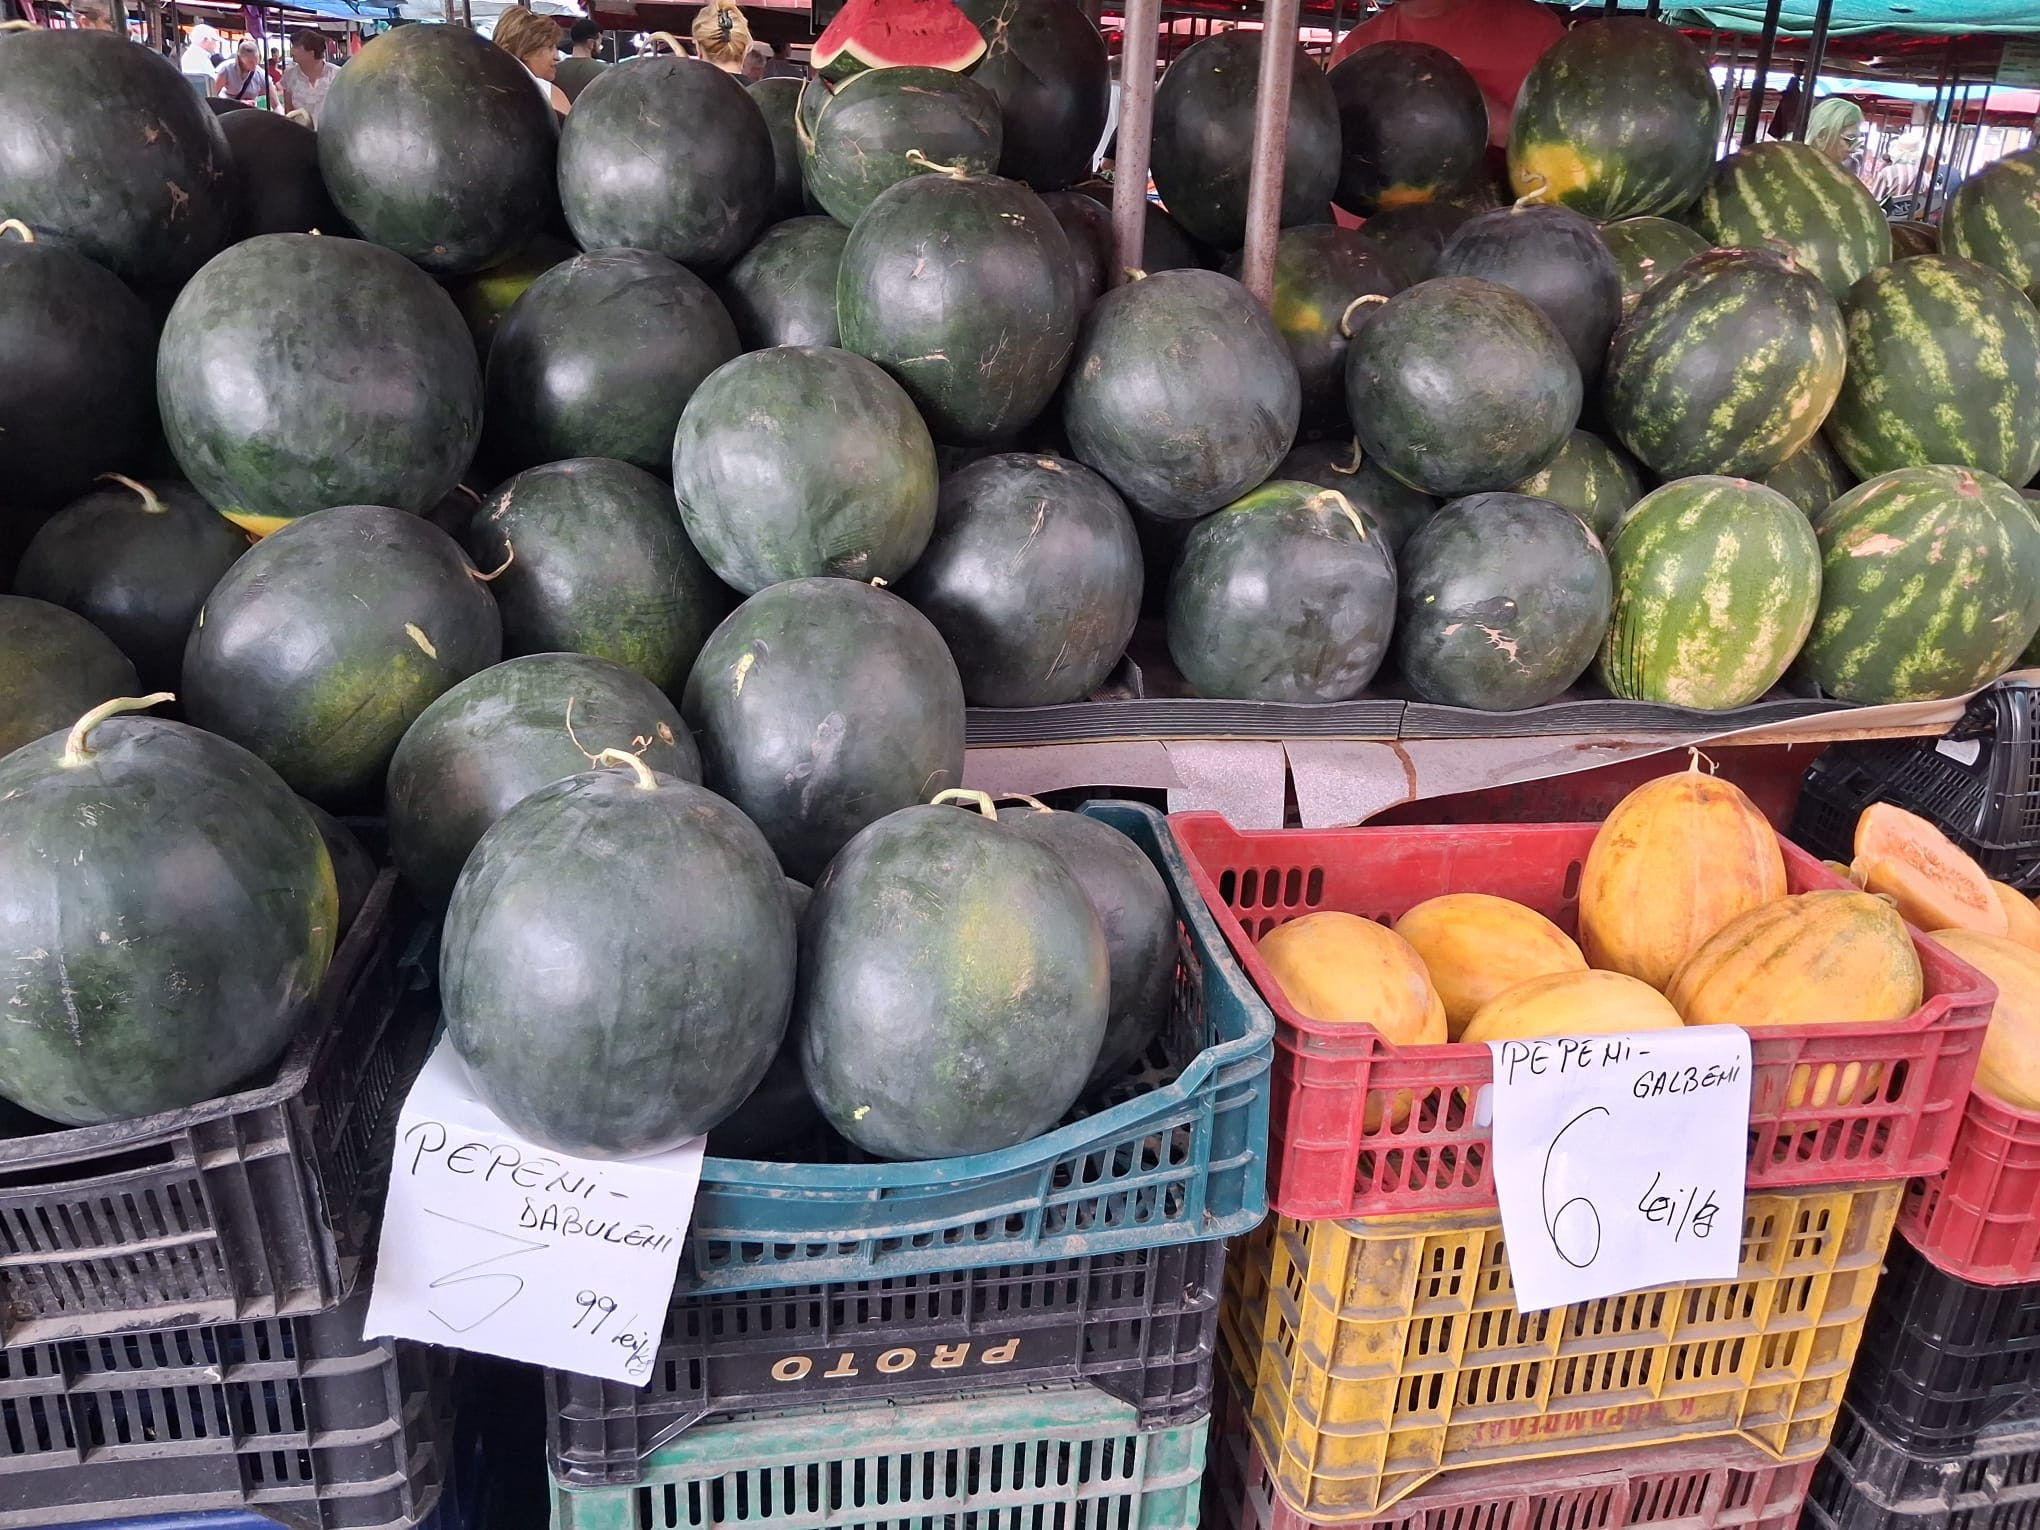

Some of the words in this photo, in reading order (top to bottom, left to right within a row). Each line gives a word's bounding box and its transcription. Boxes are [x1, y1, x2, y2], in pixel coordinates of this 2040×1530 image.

[1542, 1106, 1611, 1268] 6
[572, 1289, 618, 1335] 99
[770, 1337, 1021, 1382] PROTO
